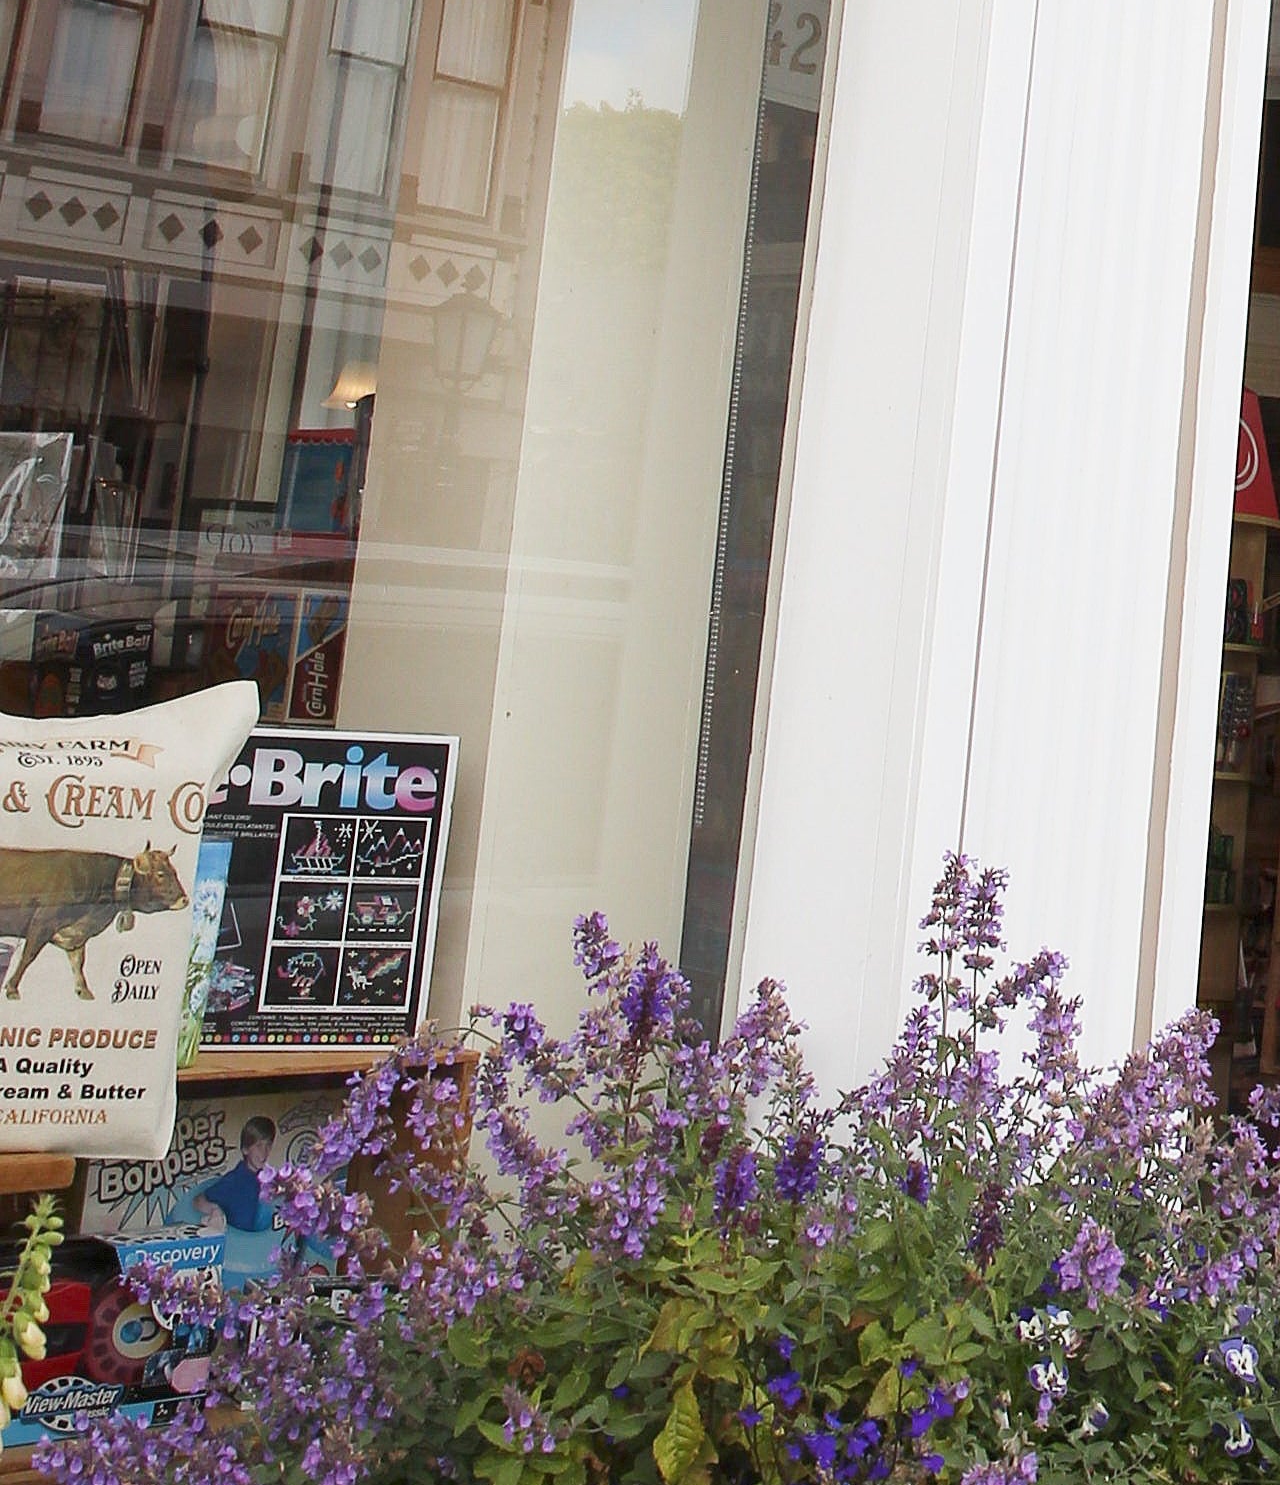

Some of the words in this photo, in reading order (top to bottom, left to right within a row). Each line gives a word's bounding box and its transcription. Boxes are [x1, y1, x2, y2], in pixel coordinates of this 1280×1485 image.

[56, 739, 131, 752] FARM
[3, 780, 31, 814] &
[45, 774, 157, 829] CREAM
[120, 954, 162, 977] OPEN
[111, 979, 160, 1004] DAILY
[48, 1027, 158, 1049] PRODUCE
[16, 1058, 94, 1078] Quality
[57, 1084, 72, 1099] &
[80, 1084, 147, 1100] Butter
[98, 1136, 228, 1203] Boppers
[25, 1386, 119, 1418] View-Master
